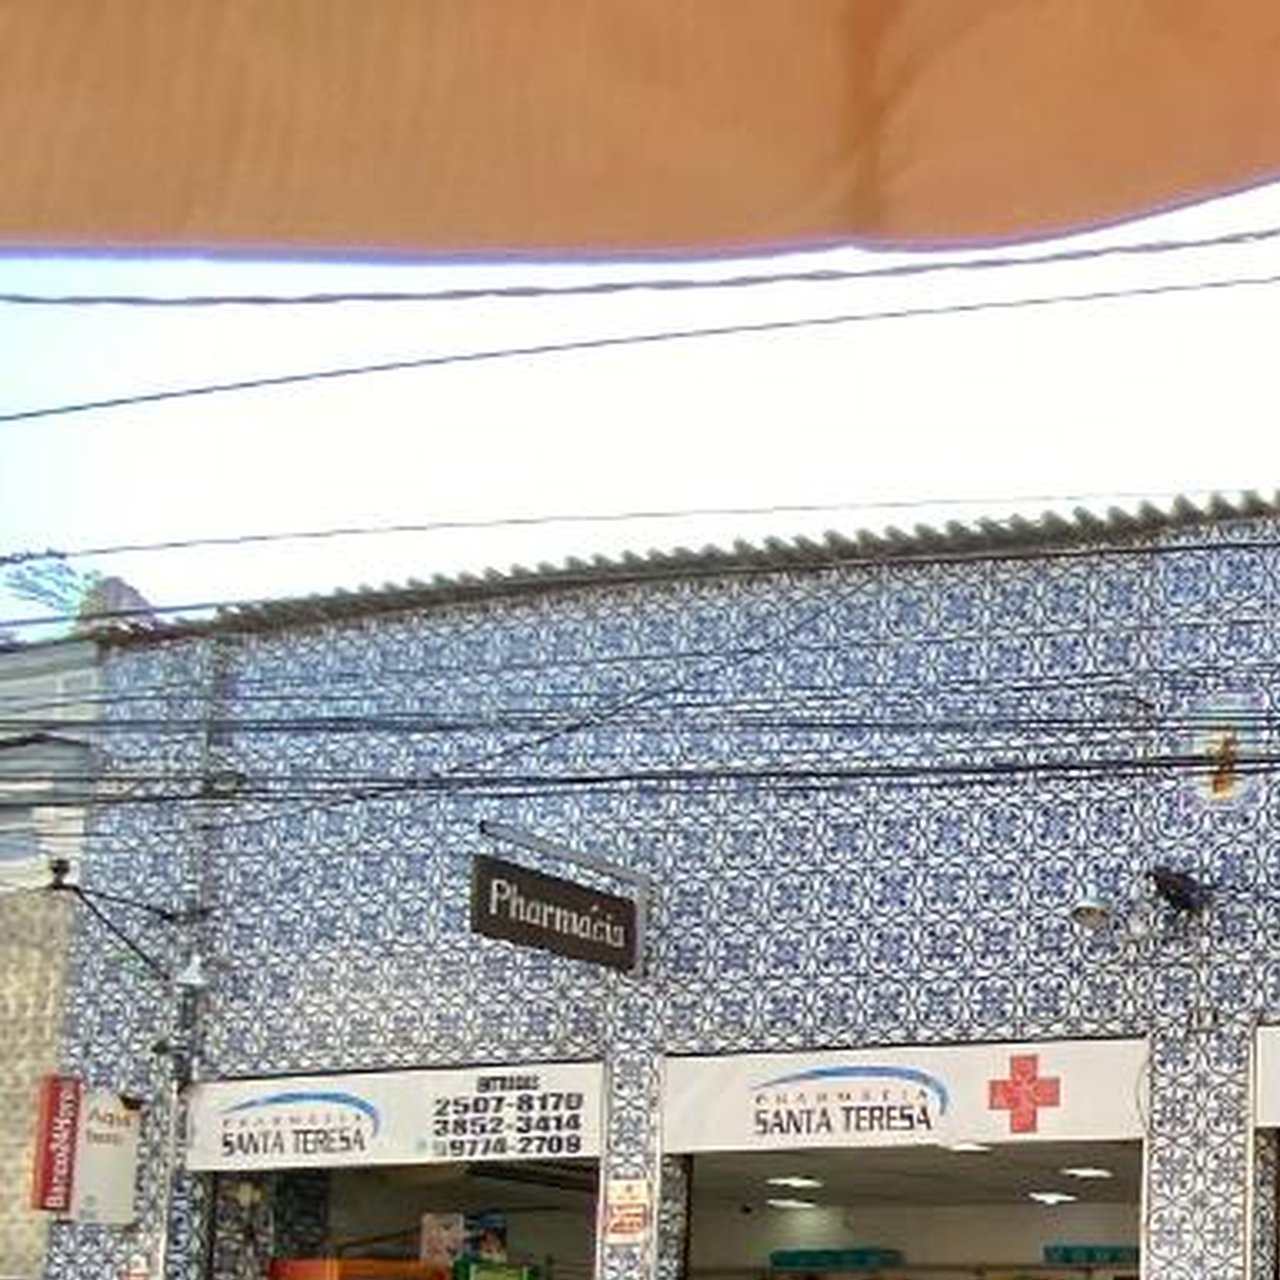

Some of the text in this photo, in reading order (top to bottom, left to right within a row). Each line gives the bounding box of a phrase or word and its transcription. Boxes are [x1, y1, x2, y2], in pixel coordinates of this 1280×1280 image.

[433, 1113, 582, 1137] 3852-3414
[755, 1104, 932, 1134] SANTA TERESA
[221, 1128, 366, 1157] SANTA TERESA
